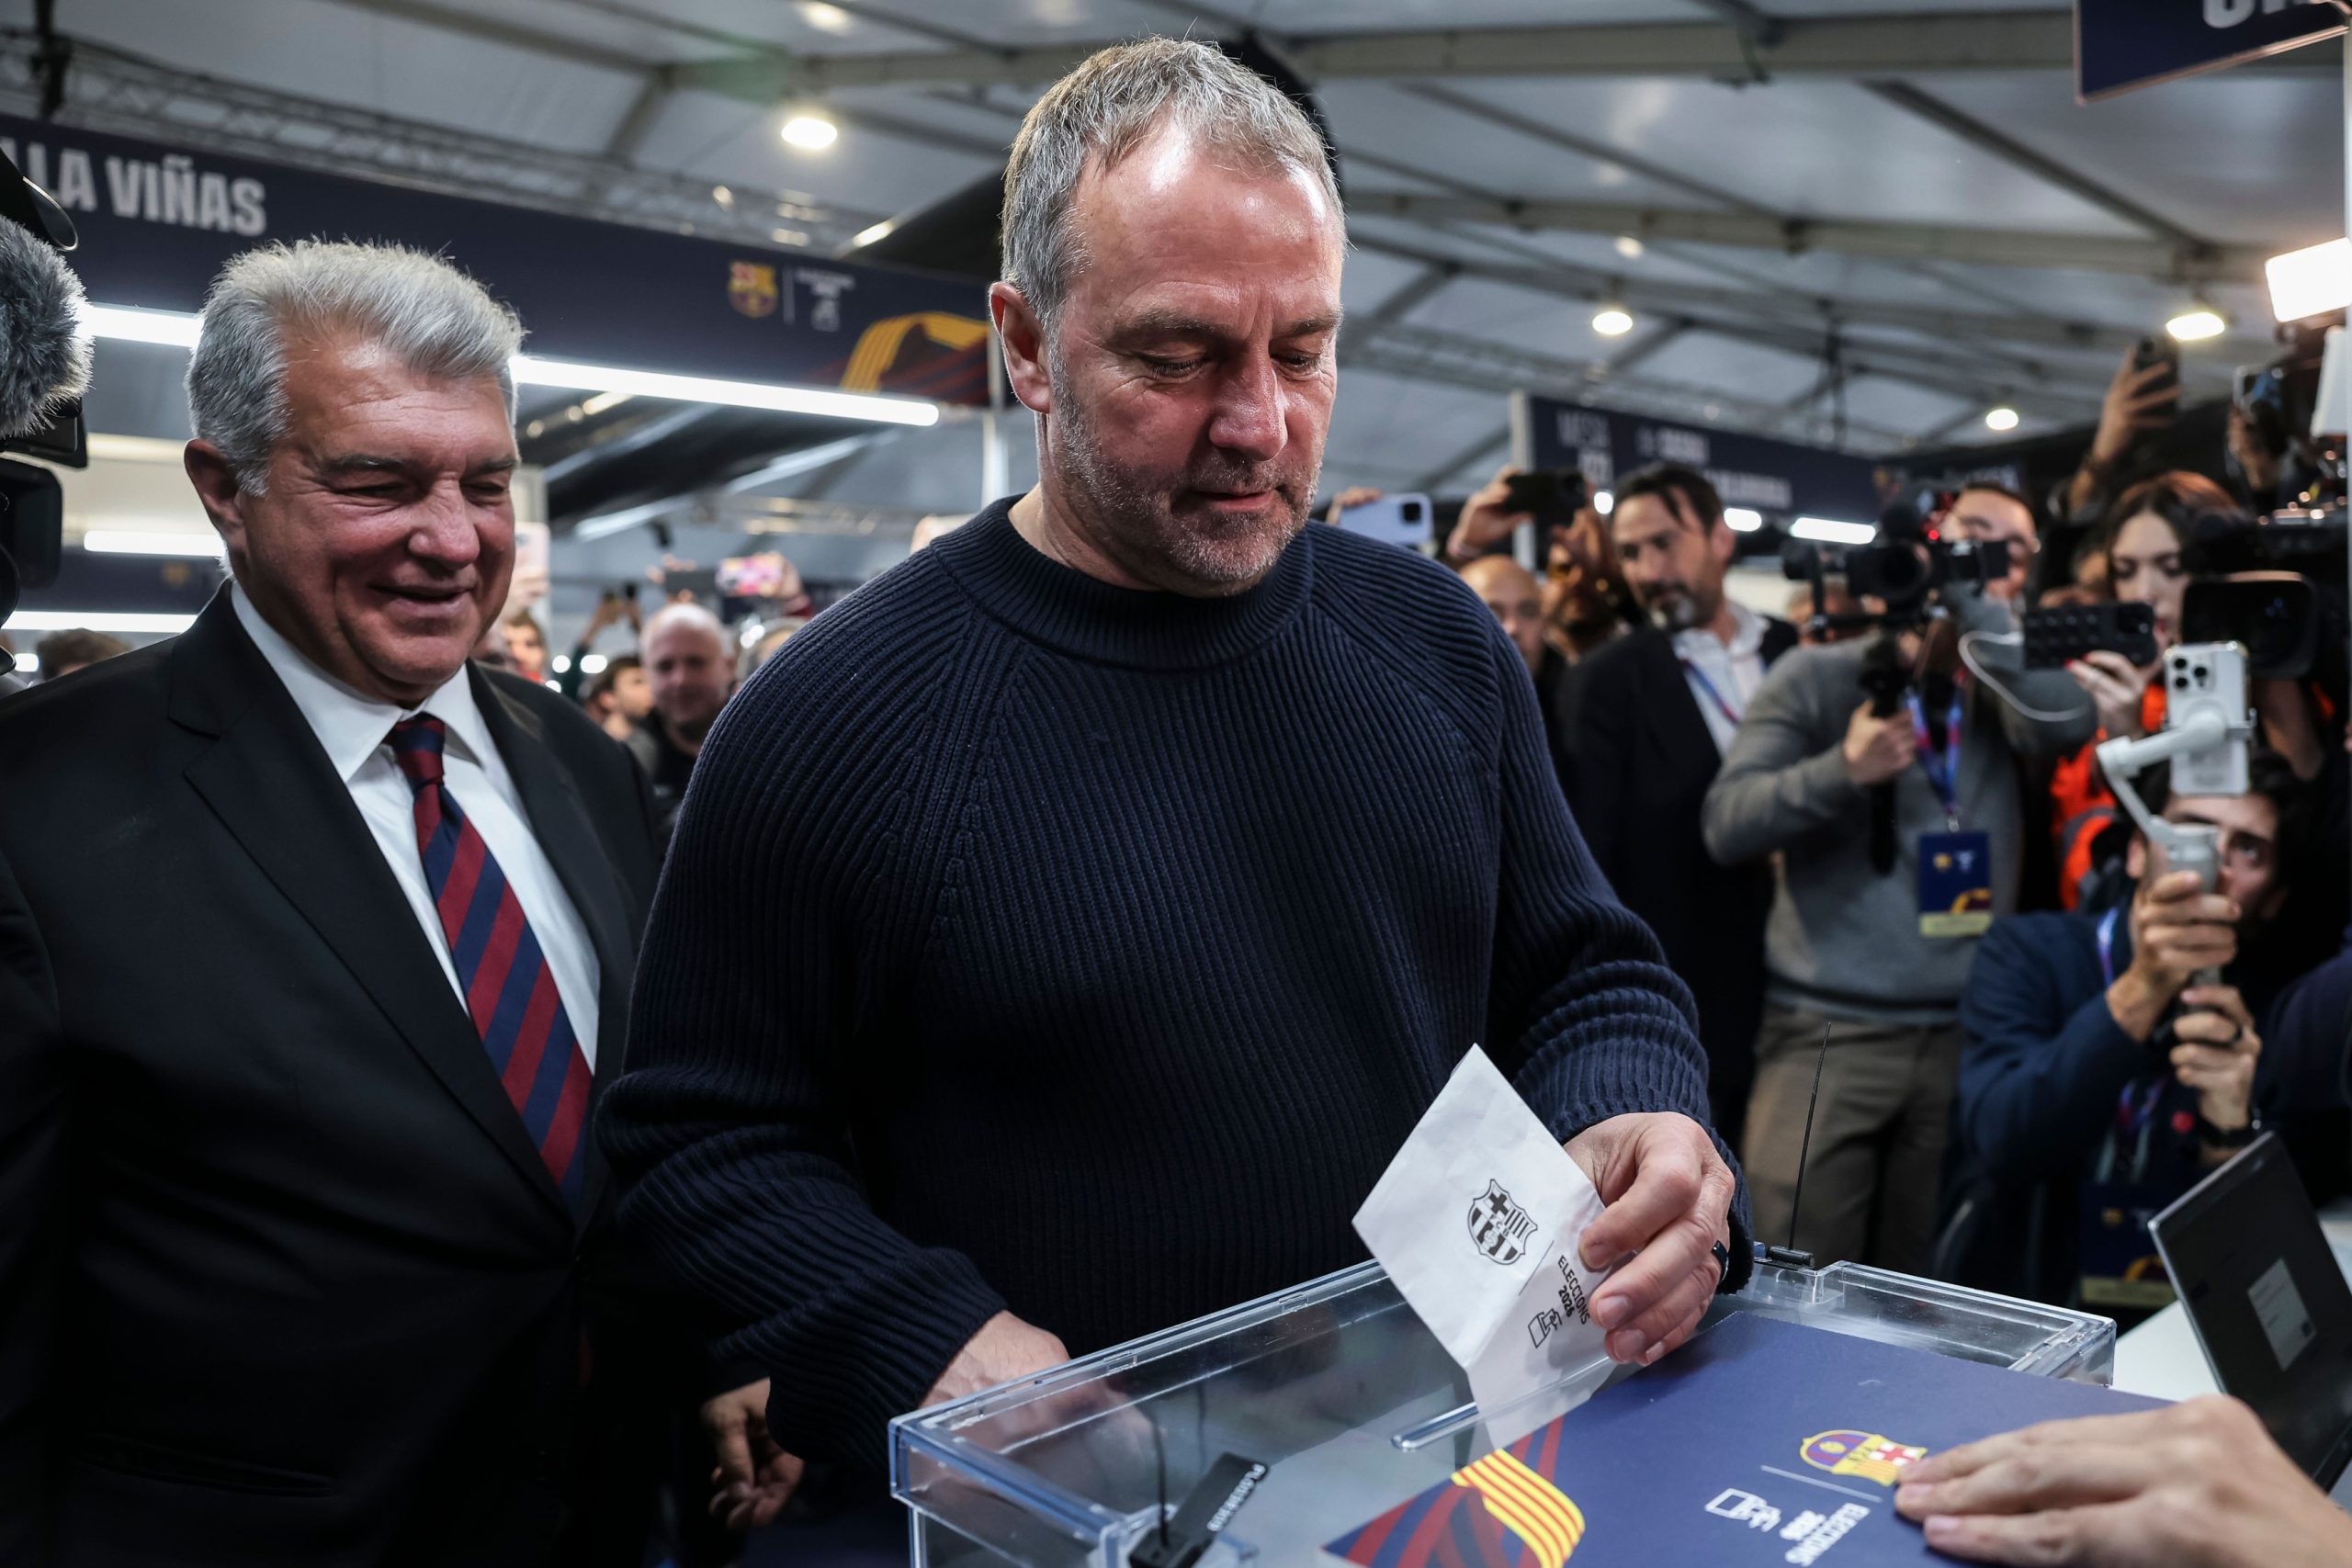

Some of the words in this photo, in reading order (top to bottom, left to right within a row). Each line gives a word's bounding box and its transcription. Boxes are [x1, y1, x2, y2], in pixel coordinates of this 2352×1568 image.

[105, 153, 267, 237] VIÑAS
[1557, 1255, 1590, 1325] ELECCIONS
[1558, 1285, 1576, 1317] 2026
